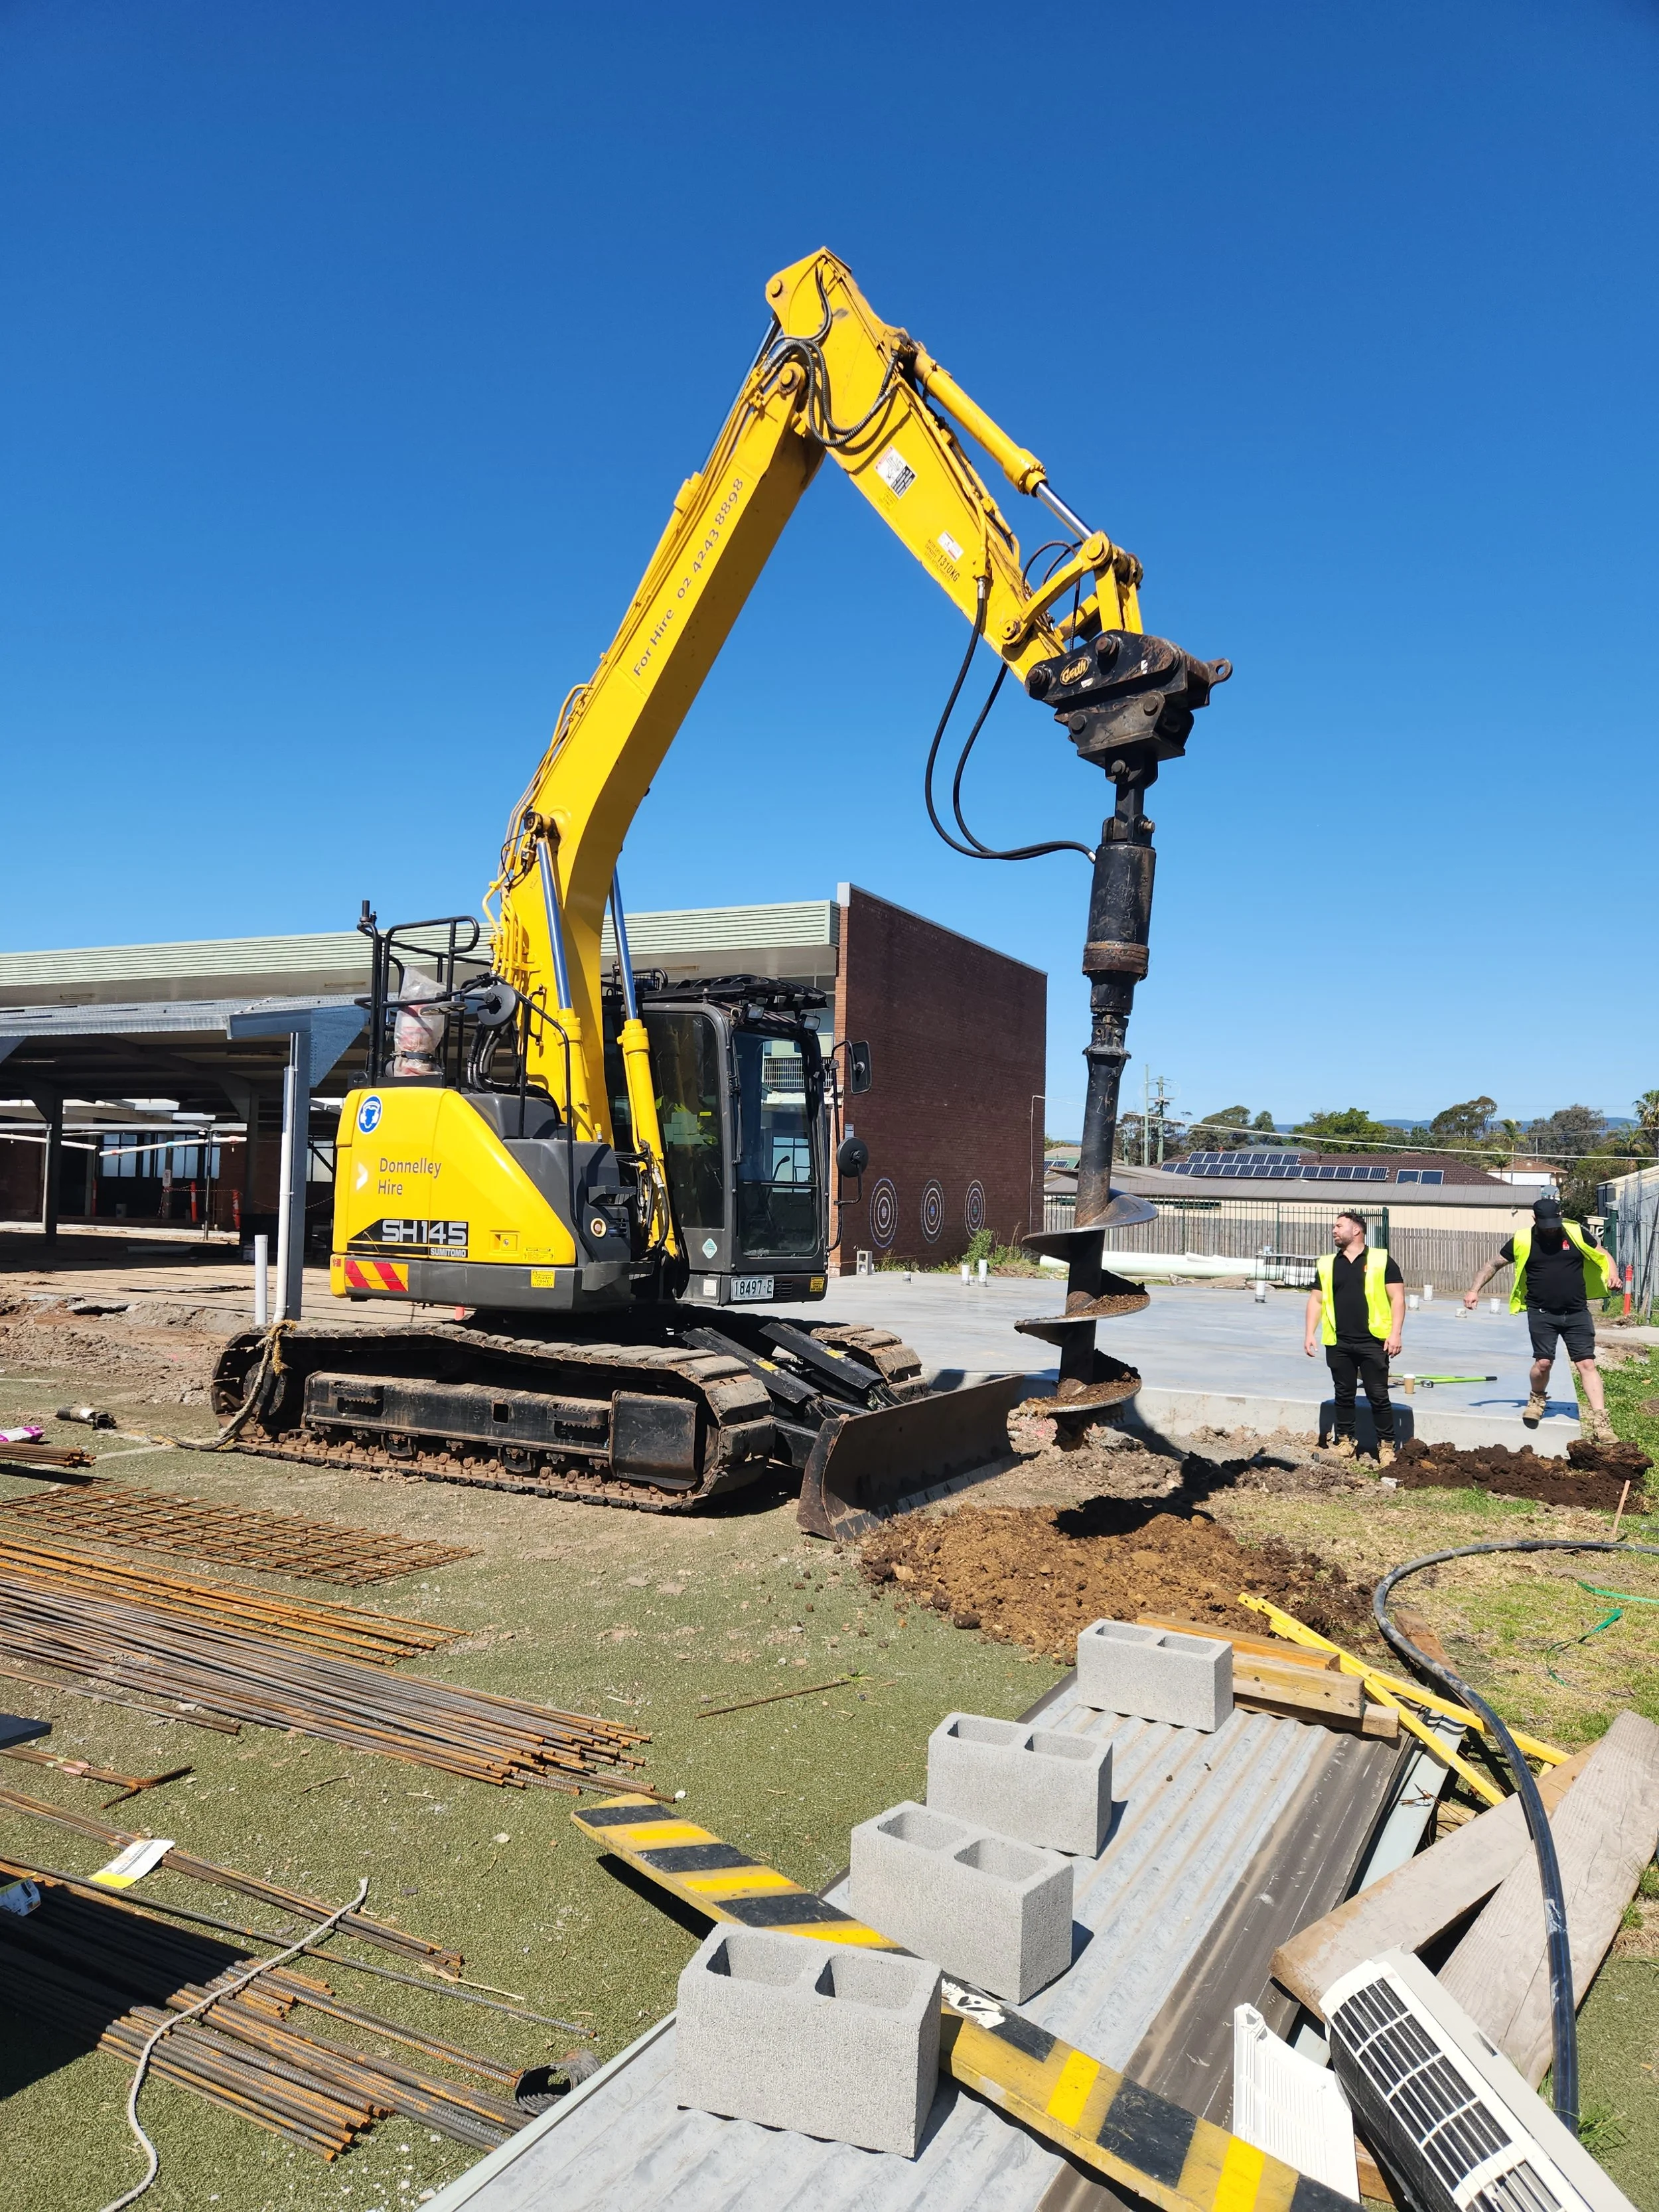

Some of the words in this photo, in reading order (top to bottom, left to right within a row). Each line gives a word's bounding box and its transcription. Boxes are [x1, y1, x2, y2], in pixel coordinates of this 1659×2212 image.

[633, 648, 652, 676] For
[650, 608, 674, 646] Hire
[677, 577, 691, 599] 02
[693, 529, 719, 573] 4243
[715, 478, 743, 525] 8898
[938, 554, 960, 582] 1310KG
[380, 1157, 441, 1179] Donnelley
[378, 1179, 403, 1195] Hire
[382, 1219, 467, 1246] SH145
[430, 1248, 467, 1257] SUMITOMO
